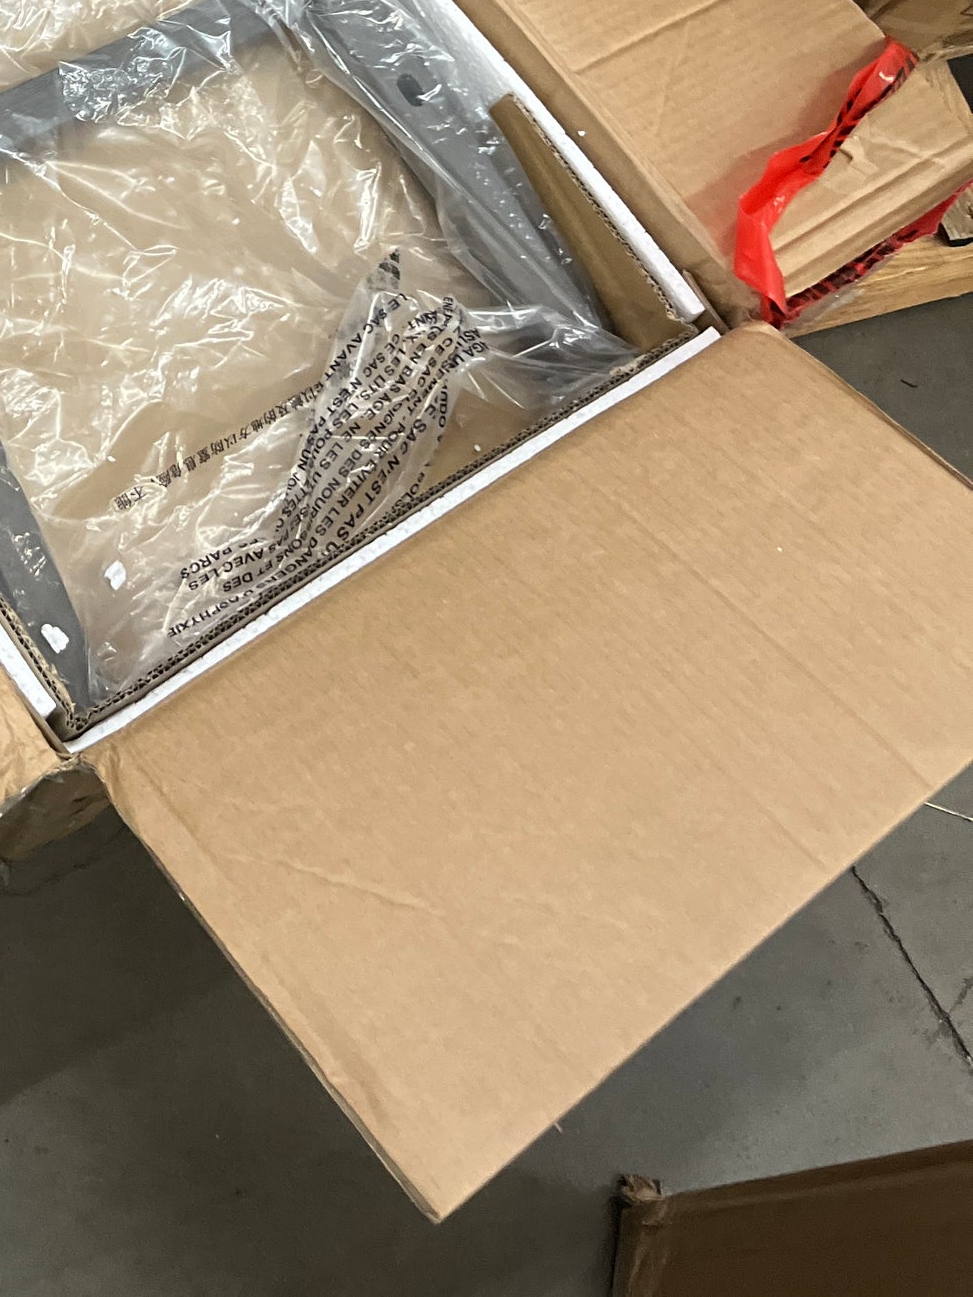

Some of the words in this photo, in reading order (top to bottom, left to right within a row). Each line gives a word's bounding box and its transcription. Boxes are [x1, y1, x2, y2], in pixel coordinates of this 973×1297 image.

[386, 291, 407, 312] LE
[362, 307, 388, 335] SAC
[320, 331, 364, 382] AVANT
[383, 332, 401, 353] CE
[408, 341, 427, 364] EN
[433, 335, 453, 357] CE
[360, 350, 386, 379] SAC
[383, 346, 406, 376] LES
[416, 356, 437, 388] SAC
[389, 364, 413, 394] BAS
[322, 376, 362, 418] N'EST
[330, 401, 358, 429] LES
[304, 415, 327, 445] PAS
[340, 420, 360, 441] NE
[374, 421, 406, 459] POUR
[395, 417, 427, 456] SAC
[295, 447, 311, 470] UN
[318, 441, 343, 470] LES
[337, 448, 362, 478] DES
[335, 458, 378, 508] ÉVITER
[361, 454, 401, 505] N'EST
[314, 506, 339, 536] LES
[334, 503, 366, 540] PAS
[221, 547, 265, 572] AVEC
[187, 568, 219, 591] LES
[221, 570, 253, 592] DES
